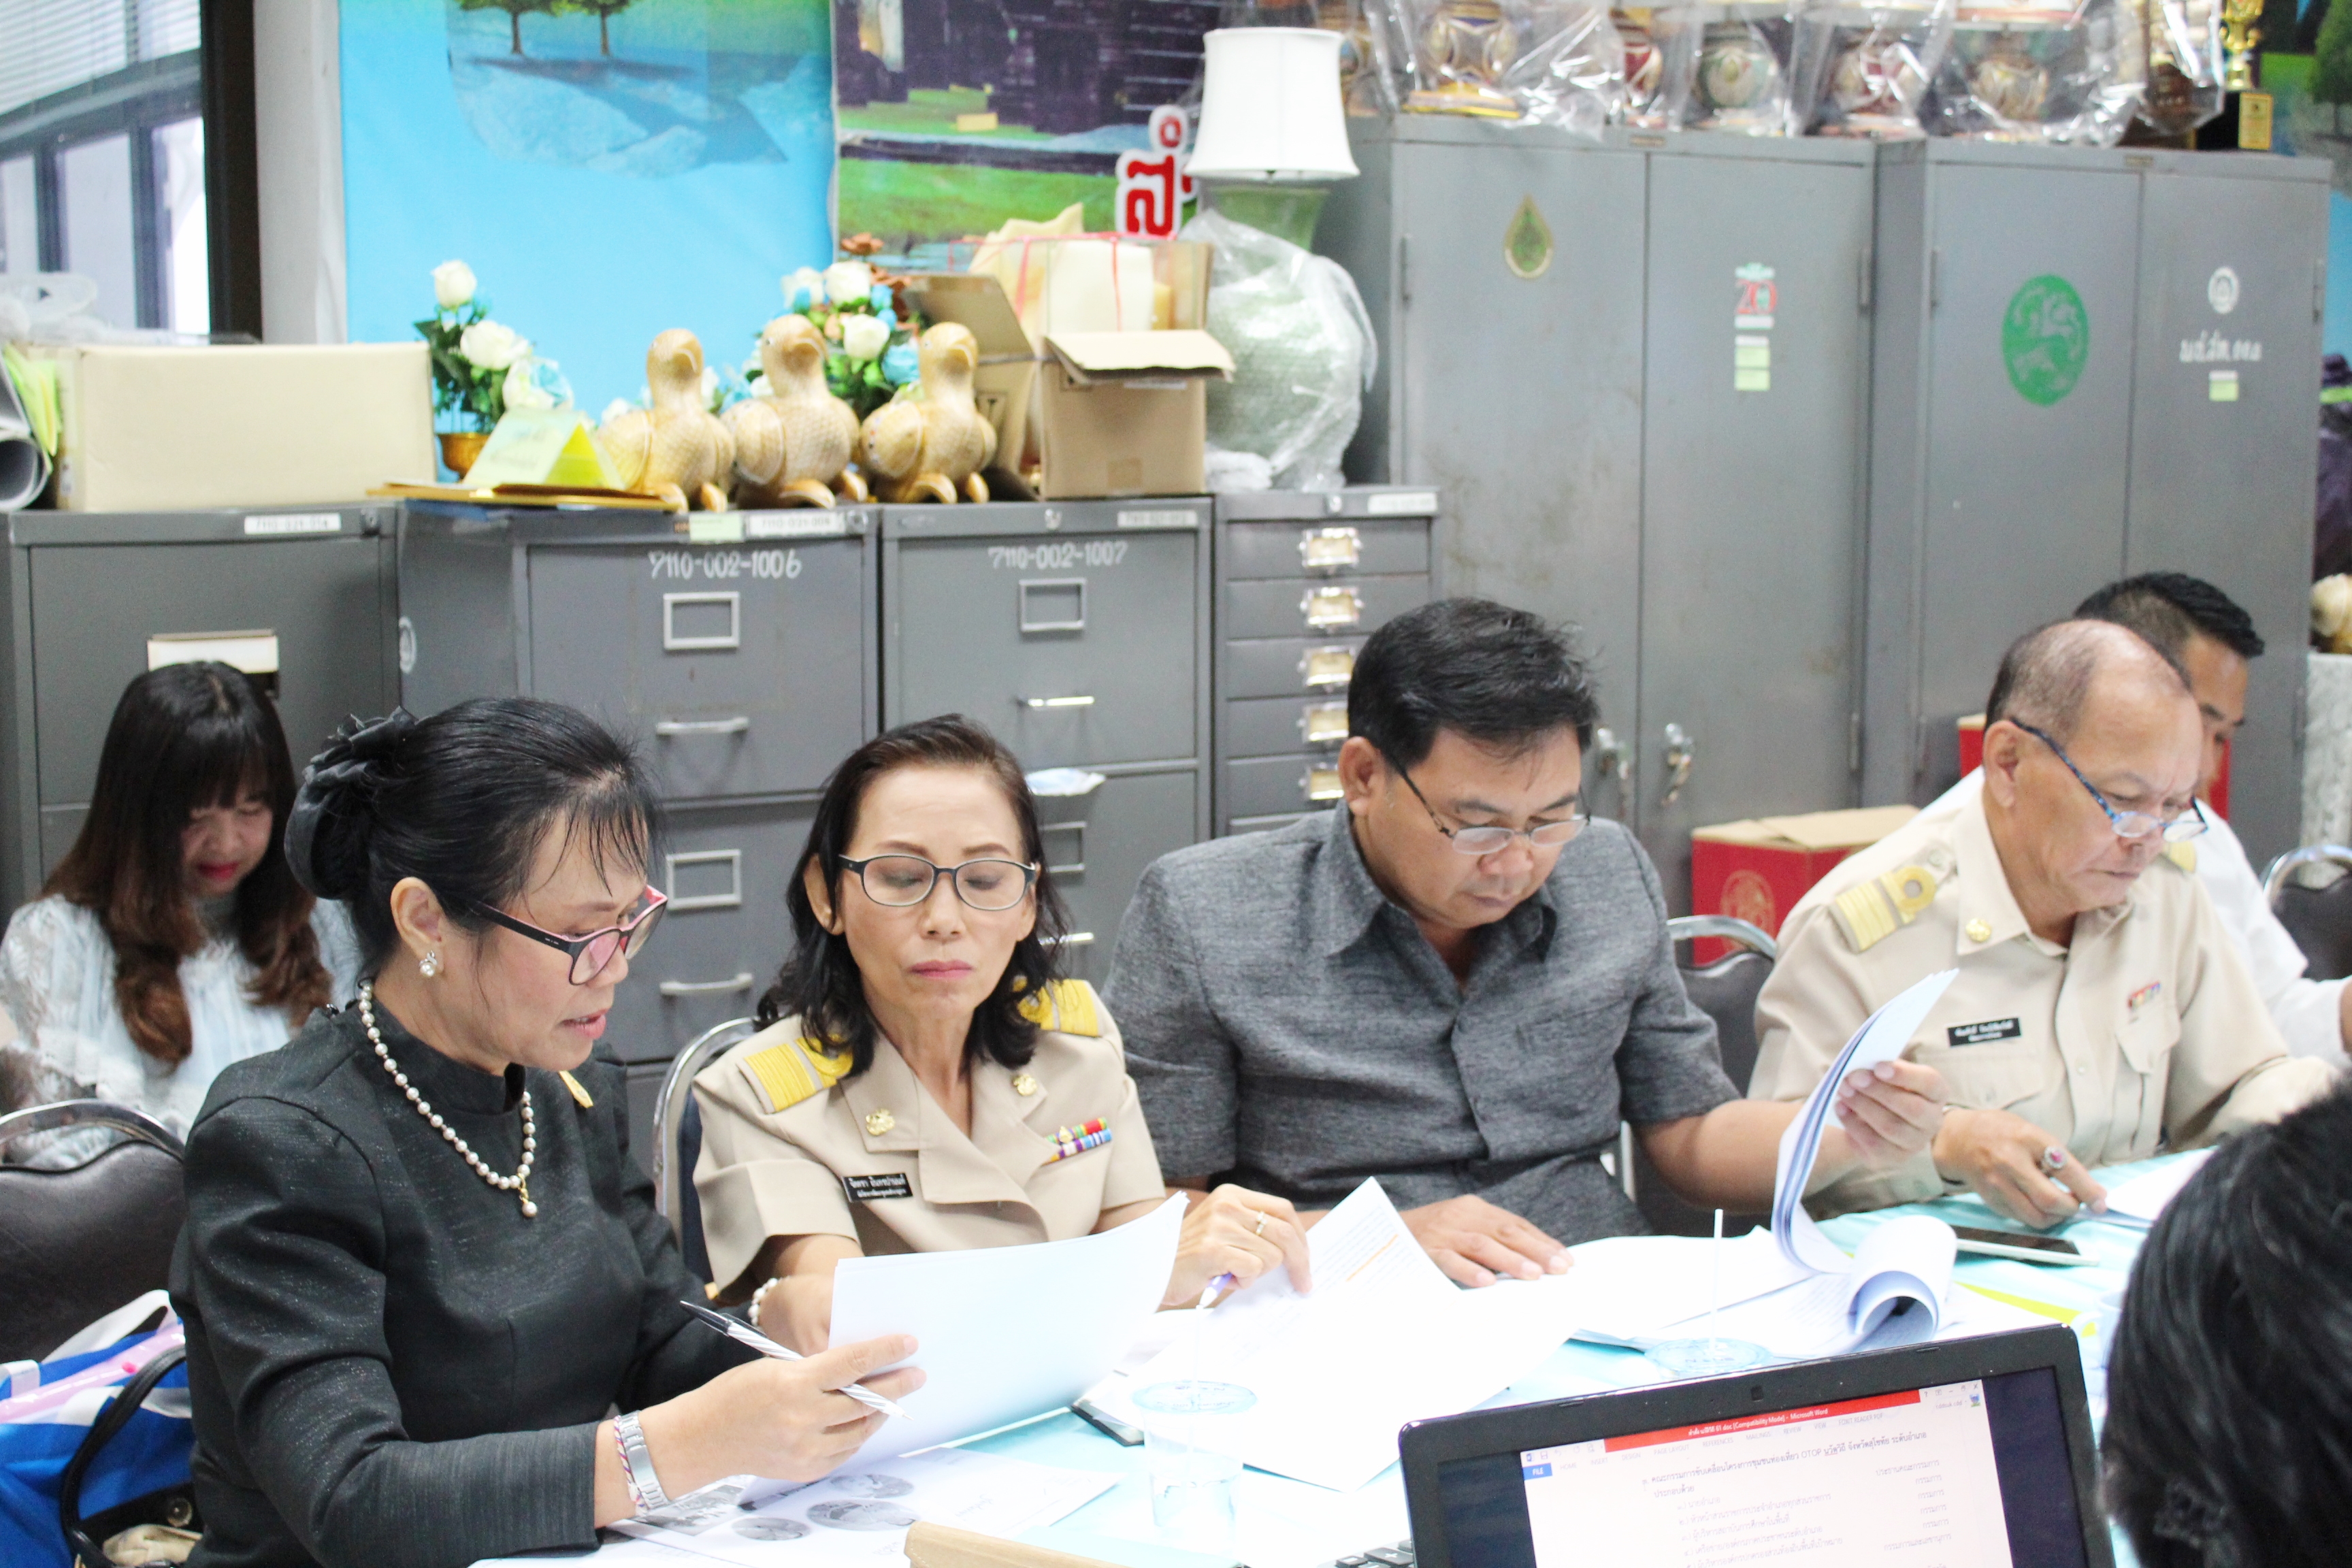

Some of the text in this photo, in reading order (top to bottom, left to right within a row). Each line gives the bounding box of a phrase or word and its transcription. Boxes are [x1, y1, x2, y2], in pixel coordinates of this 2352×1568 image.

[648, 548, 802, 579] 7110-002-1006
[987, 540, 1128, 570] 7110-002-1007
[1790, 1410, 1814, 1420] Microsoft
[1814, 1407, 1829, 1416] Word
[1532, 1467, 1544, 1476] FILE
[1560, 1463, 1577, 1471] HOME
[1590, 1456, 1608, 1465] INSERT
[1621, 1452, 1642, 1460] DESIGN
[1654, 1448, 1667, 1456] PAGE
[1668, 1444, 1690, 1453] LAYOUT
[1702, 1437, 1734, 1448] REFERENCES
[1746, 1431, 1771, 1441] MAILINGS
[1783, 1426, 1801, 1435] REVIEW
[1814, 1422, 1827, 1430] VIEW
[1801, 1448, 1822, 1458] OTOP
[1891, 1428, 1927, 1443] ระดับอำเภอ
[1654, 1482, 1695, 1499] ประกอบด้วย
